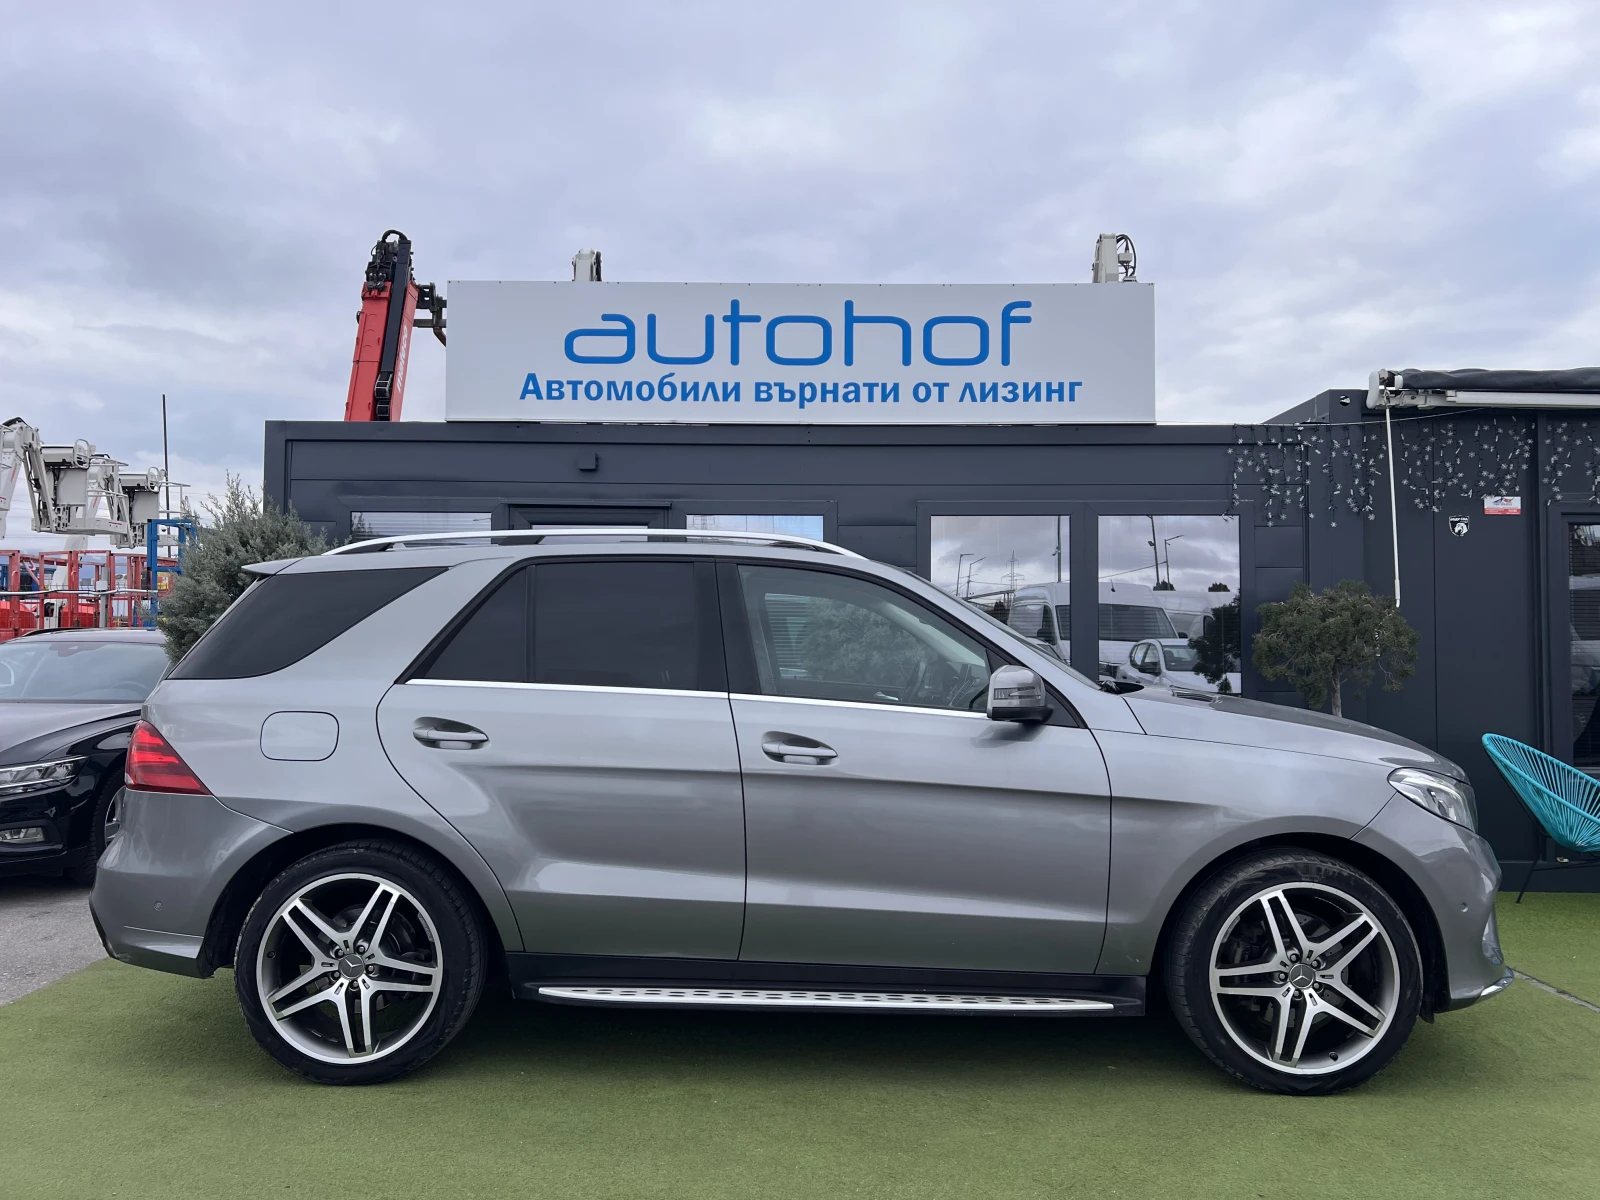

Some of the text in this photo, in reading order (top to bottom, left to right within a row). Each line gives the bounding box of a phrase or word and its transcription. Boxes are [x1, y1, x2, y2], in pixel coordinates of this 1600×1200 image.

[564, 299, 1033, 367] autohof
[519, 372, 1083, 409] Автомобили върнати от лизинг
